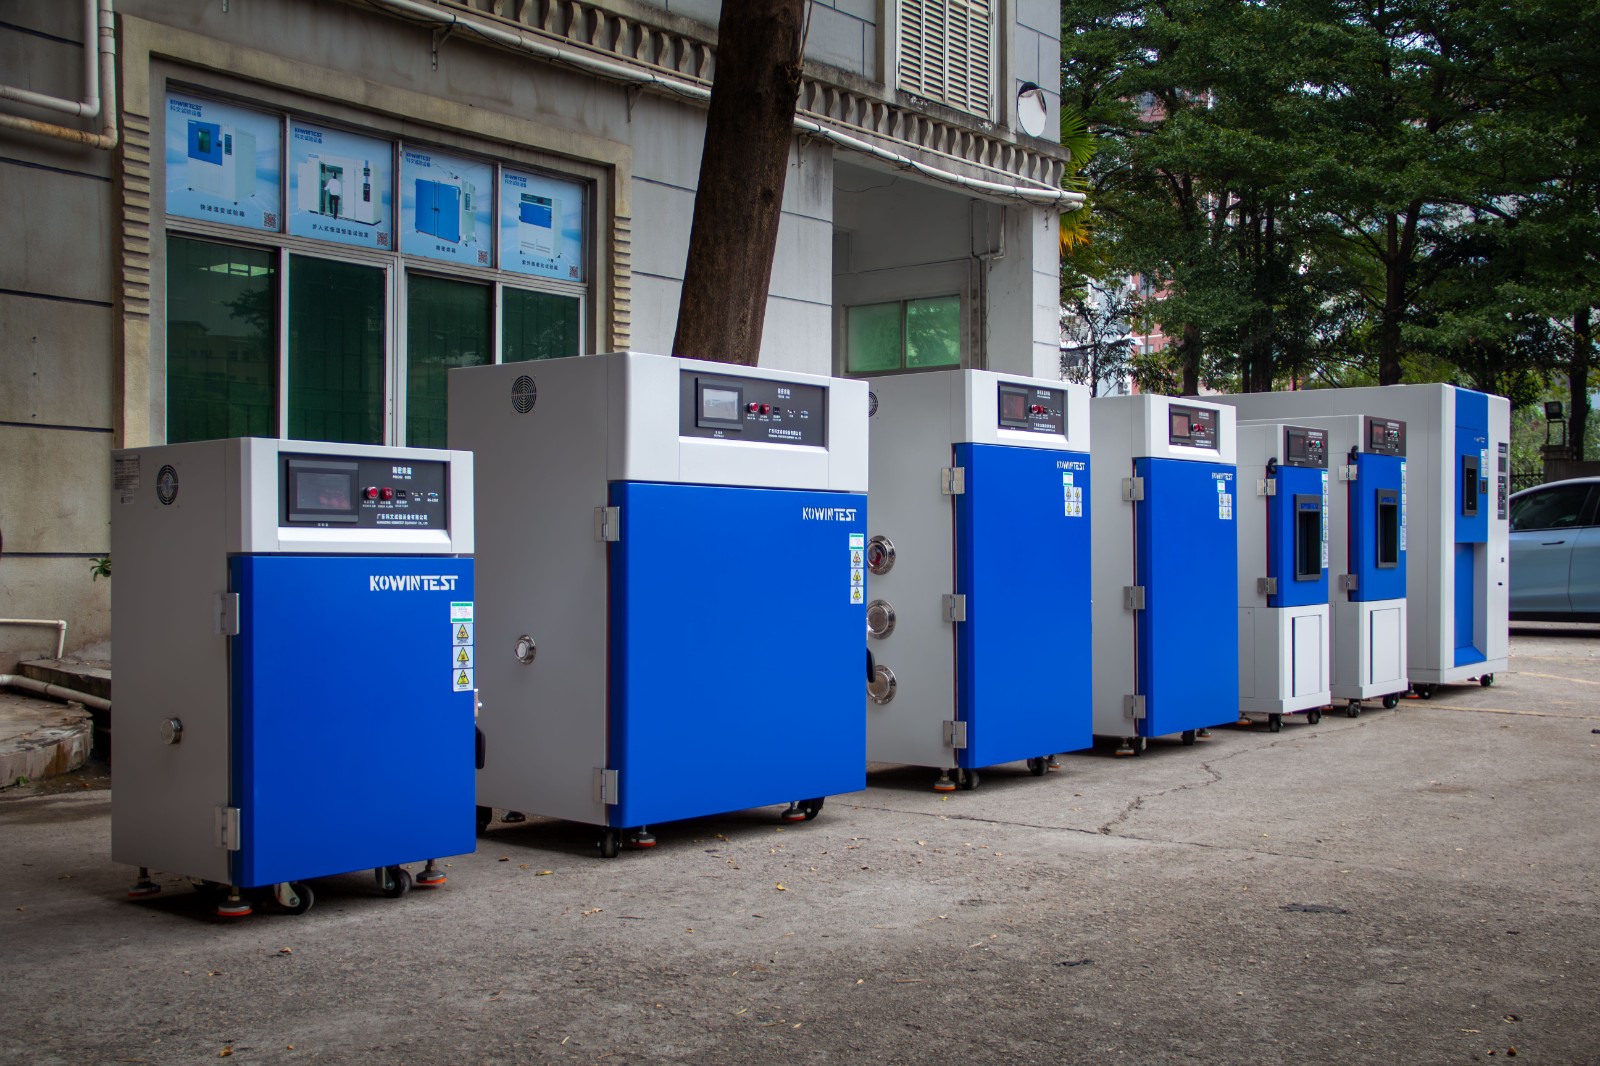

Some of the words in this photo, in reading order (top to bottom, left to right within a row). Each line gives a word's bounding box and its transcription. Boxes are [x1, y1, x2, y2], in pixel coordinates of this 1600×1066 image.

[170, 105, 202, 117] 科文试验设备
[200, 203, 245, 217] 快速温变试验箱
[802, 506, 857, 522] KOWINTEST
[369, 575, 459, 592] KOWINTEST
